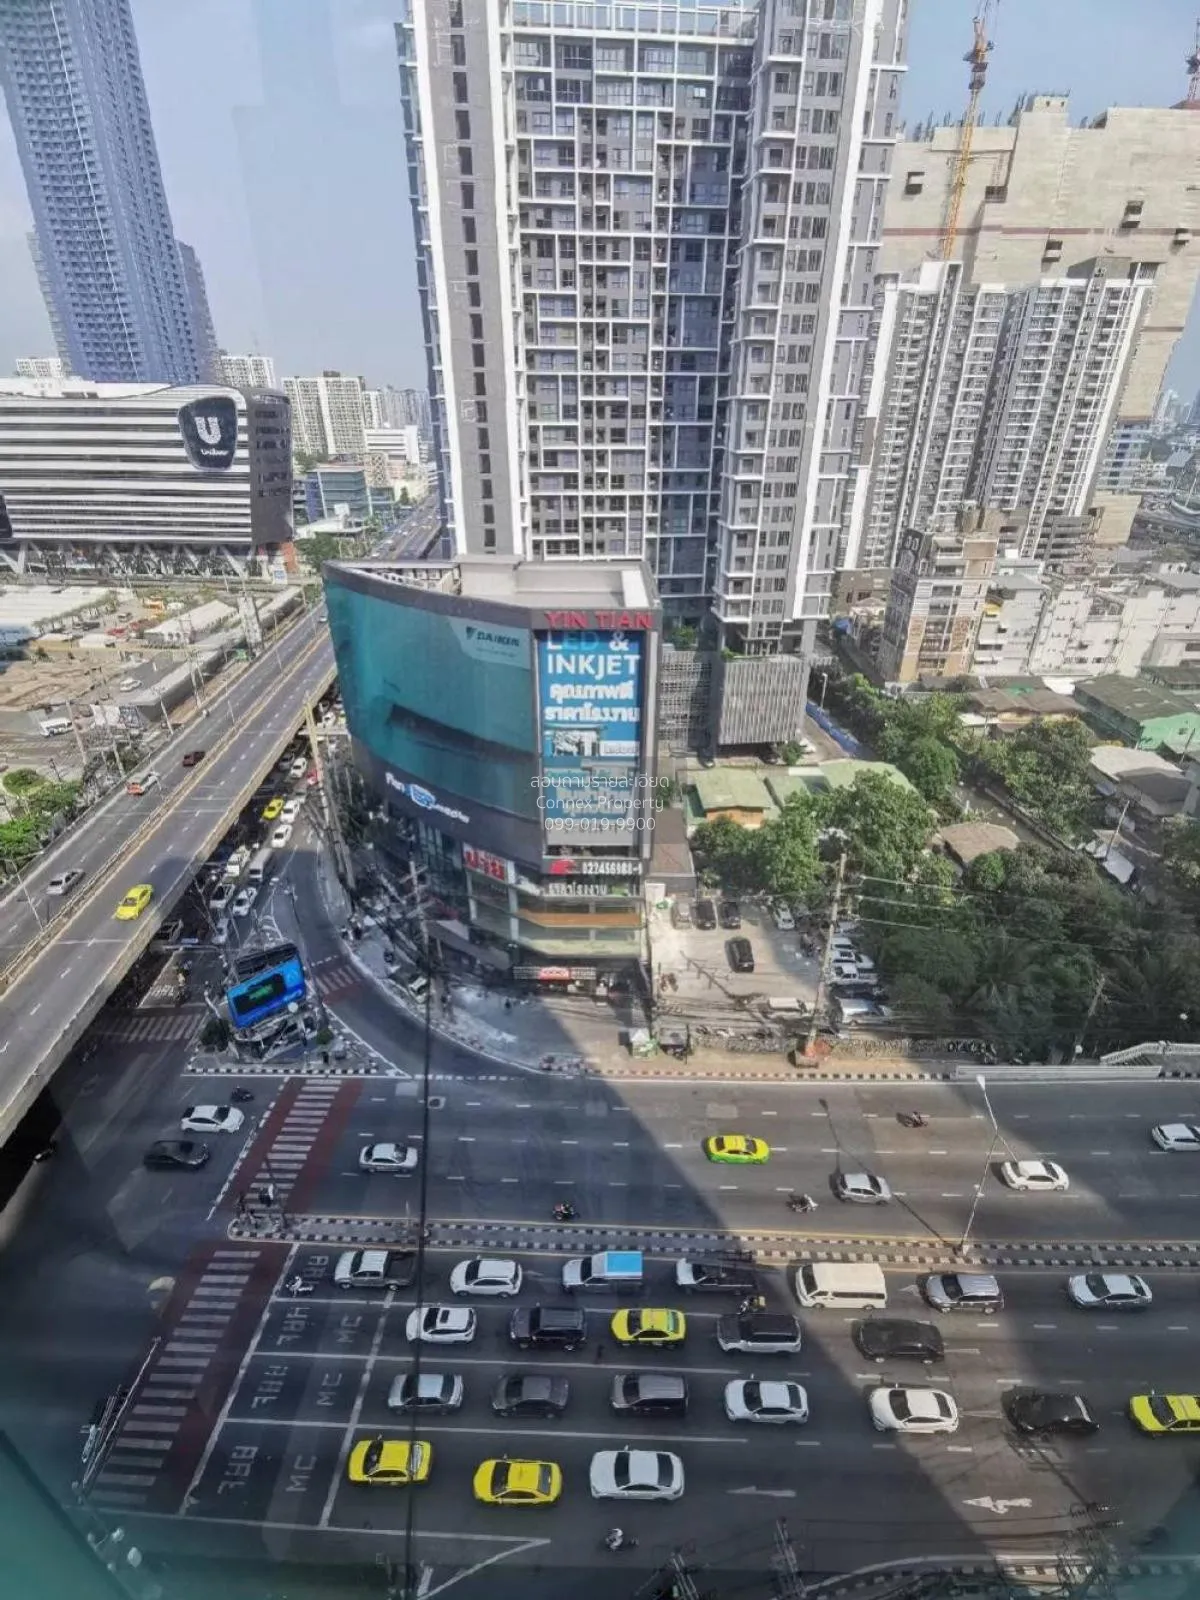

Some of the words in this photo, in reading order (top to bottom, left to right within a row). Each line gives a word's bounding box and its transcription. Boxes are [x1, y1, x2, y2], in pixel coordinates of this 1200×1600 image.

[543, 610, 589, 629] YIN
[595, 610, 654, 629] TIAN
[546, 630, 600, 651] LED
[608, 630, 630, 651] &
[547, 654, 641, 680] INKJET
